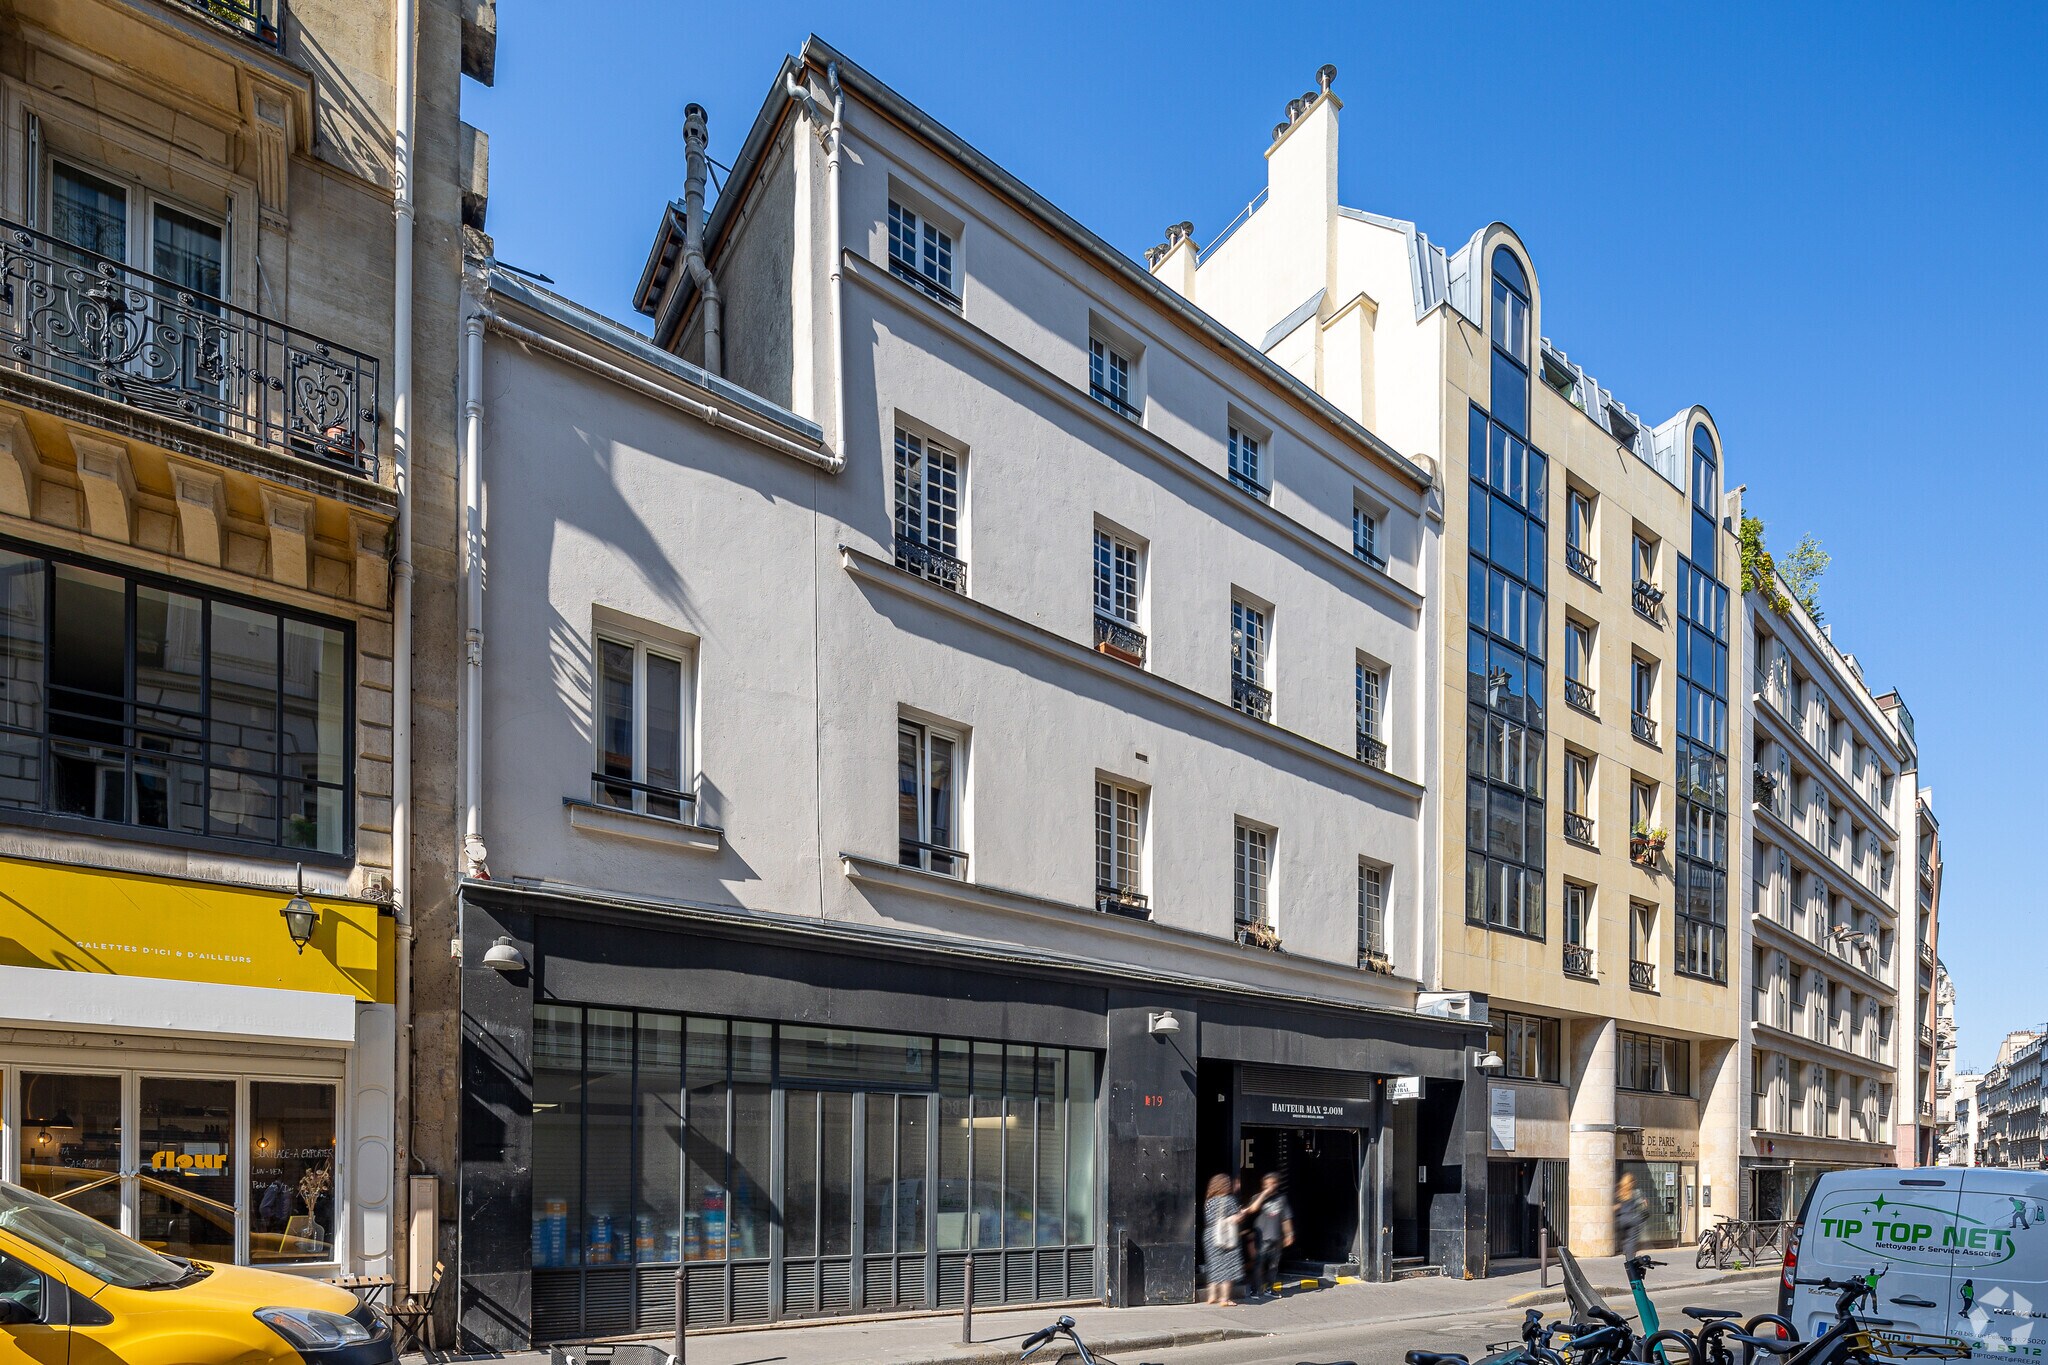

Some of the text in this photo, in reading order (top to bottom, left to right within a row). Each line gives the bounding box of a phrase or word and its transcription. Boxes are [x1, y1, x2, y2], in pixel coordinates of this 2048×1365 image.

[75, 940, 138, 953] GALETTES
[142, 946, 171, 957] D'ICI
[187, 951, 252, 964] D'AILLEURS
[1272, 1103, 1343, 1116] HAUTEUR MAX 2.00M
[1627, 1134, 1675, 1147] VILLE DE PARIS
[151, 1150, 228, 1169] flour
[1820, 1218, 2012, 1251] TIP TOP NET
[1875, 1242, 1917, 1253] Nettoyage
[1927, 1246, 1960, 1255] Service
[1962, 1248, 2002, 1258] Associés
